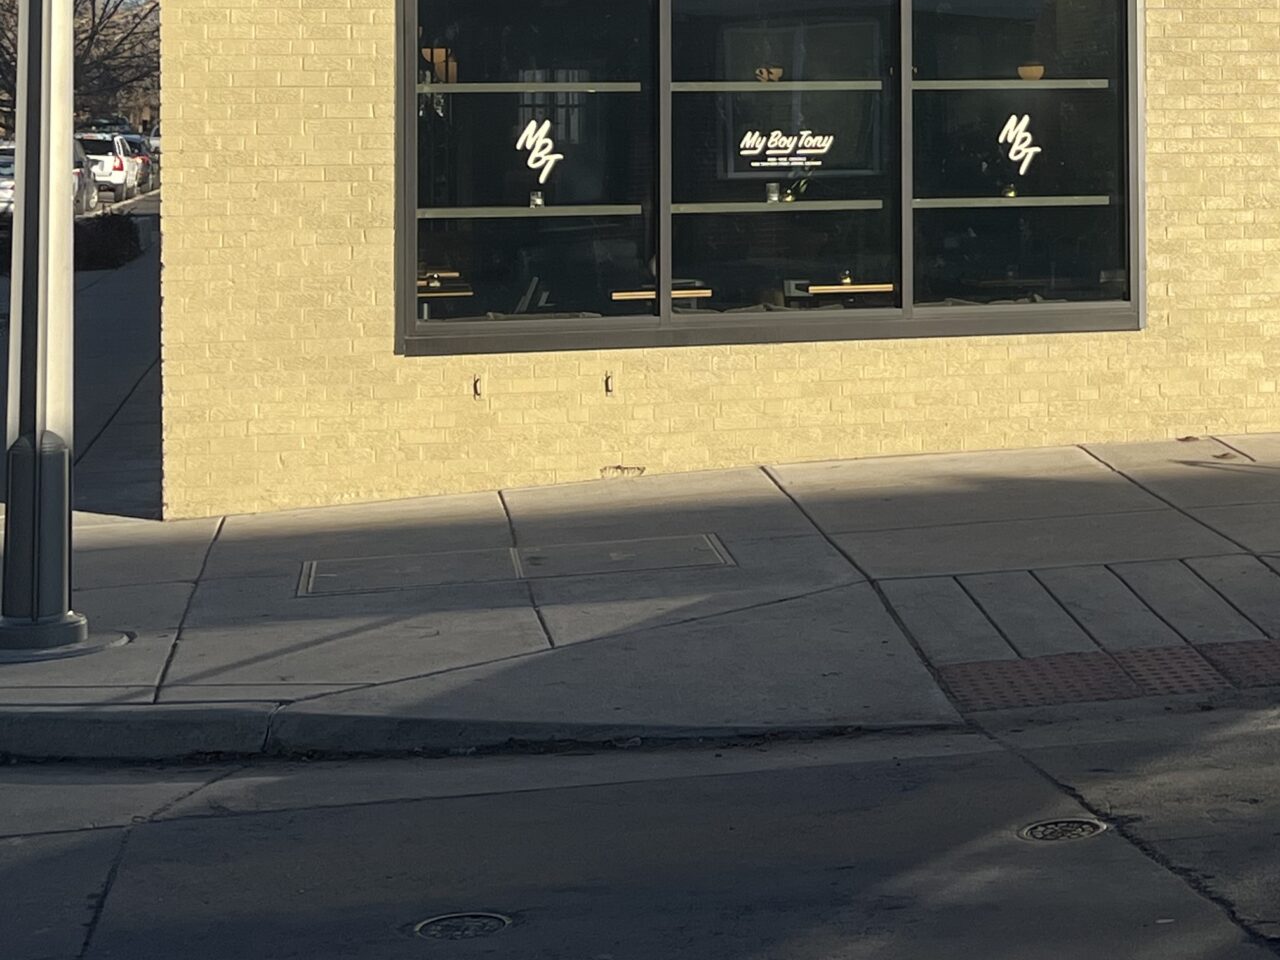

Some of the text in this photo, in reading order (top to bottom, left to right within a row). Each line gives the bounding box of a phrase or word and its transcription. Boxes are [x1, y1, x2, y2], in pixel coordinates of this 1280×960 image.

[516, 119, 564, 184] MBT
[740, 129, 834, 155] My Boy Tony
[998, 114, 1042, 176] MBT
